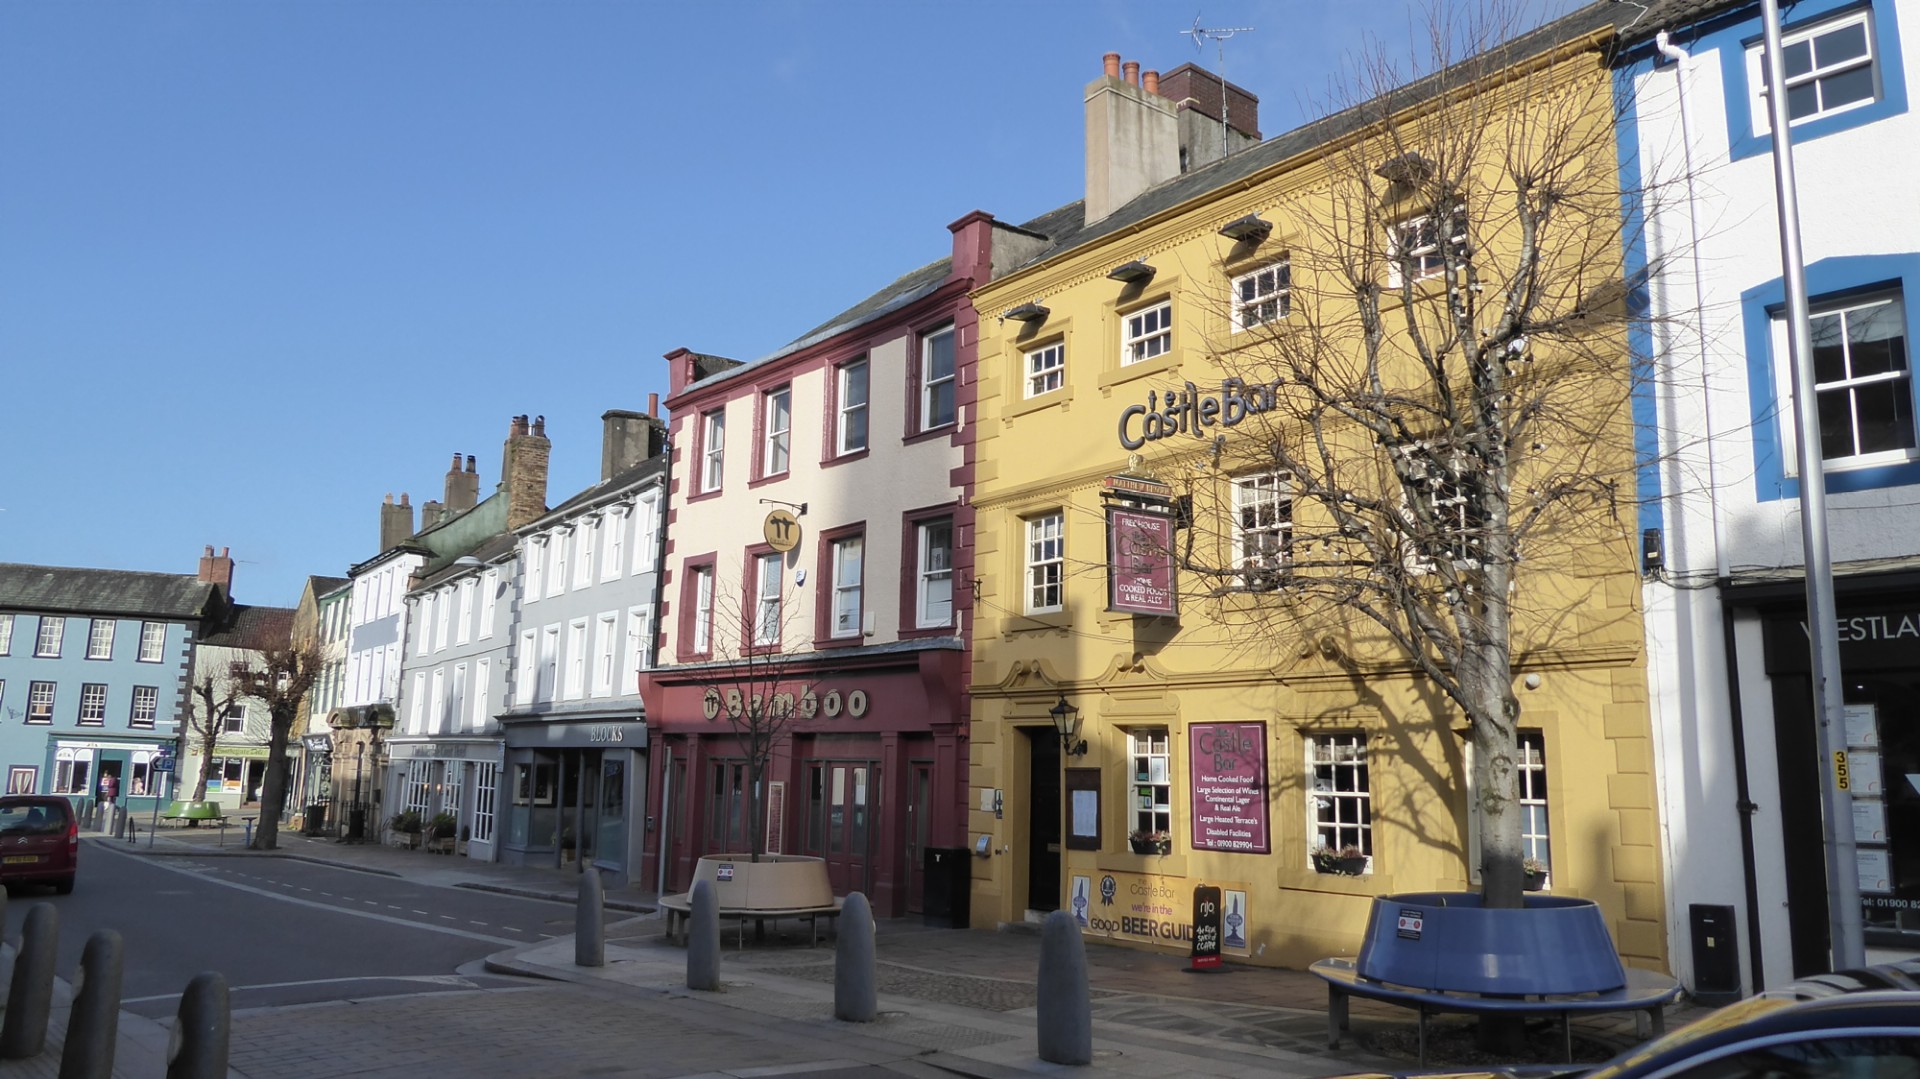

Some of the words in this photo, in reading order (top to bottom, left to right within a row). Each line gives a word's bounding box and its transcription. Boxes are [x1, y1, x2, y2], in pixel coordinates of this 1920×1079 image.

[1118, 381, 1219, 450] Castle
[1222, 377, 1285, 427] Bar
[1131, 555, 1154, 574] Bar
[1119, 584, 1145, 594] COOKED
[1130, 593, 1146, 603] REAL
[1147, 596, 1163, 605] ALES
[1800, 614, 1920, 642] ESTLA
[726, 684, 868, 720] Bamboo
[590, 725, 623, 742] BLOCKS
[1199, 728, 1253, 757] Castle
[1214, 753, 1236, 772] Bar
[1201, 775, 1217, 783] Home
[1197, 786, 1211, 795] Large
[1242, 787, 1259, 795] Wines
[1205, 795, 1235, 804] Continental
[1236, 797, 1250, 805] Lager
[1220, 804, 1231, 812] Real
[1200, 815, 1213, 824] Large
[1214, 816, 1234, 824] Heated
[1235, 817, 1258, 825] Terrace's
[1206, 828, 1228, 836] Disabled
[1229, 829, 1251, 838] Facilities
[1130, 883, 1158, 898] Castle
[1160, 886, 1174, 898] Bar
[1152, 903, 1158, 914] in
[1160, 904, 1172, 915] the
[1877, 898, 1908, 908] 01900
[1091, 918, 1120, 932] GOOD
[1122, 916, 1158, 938] BEER
